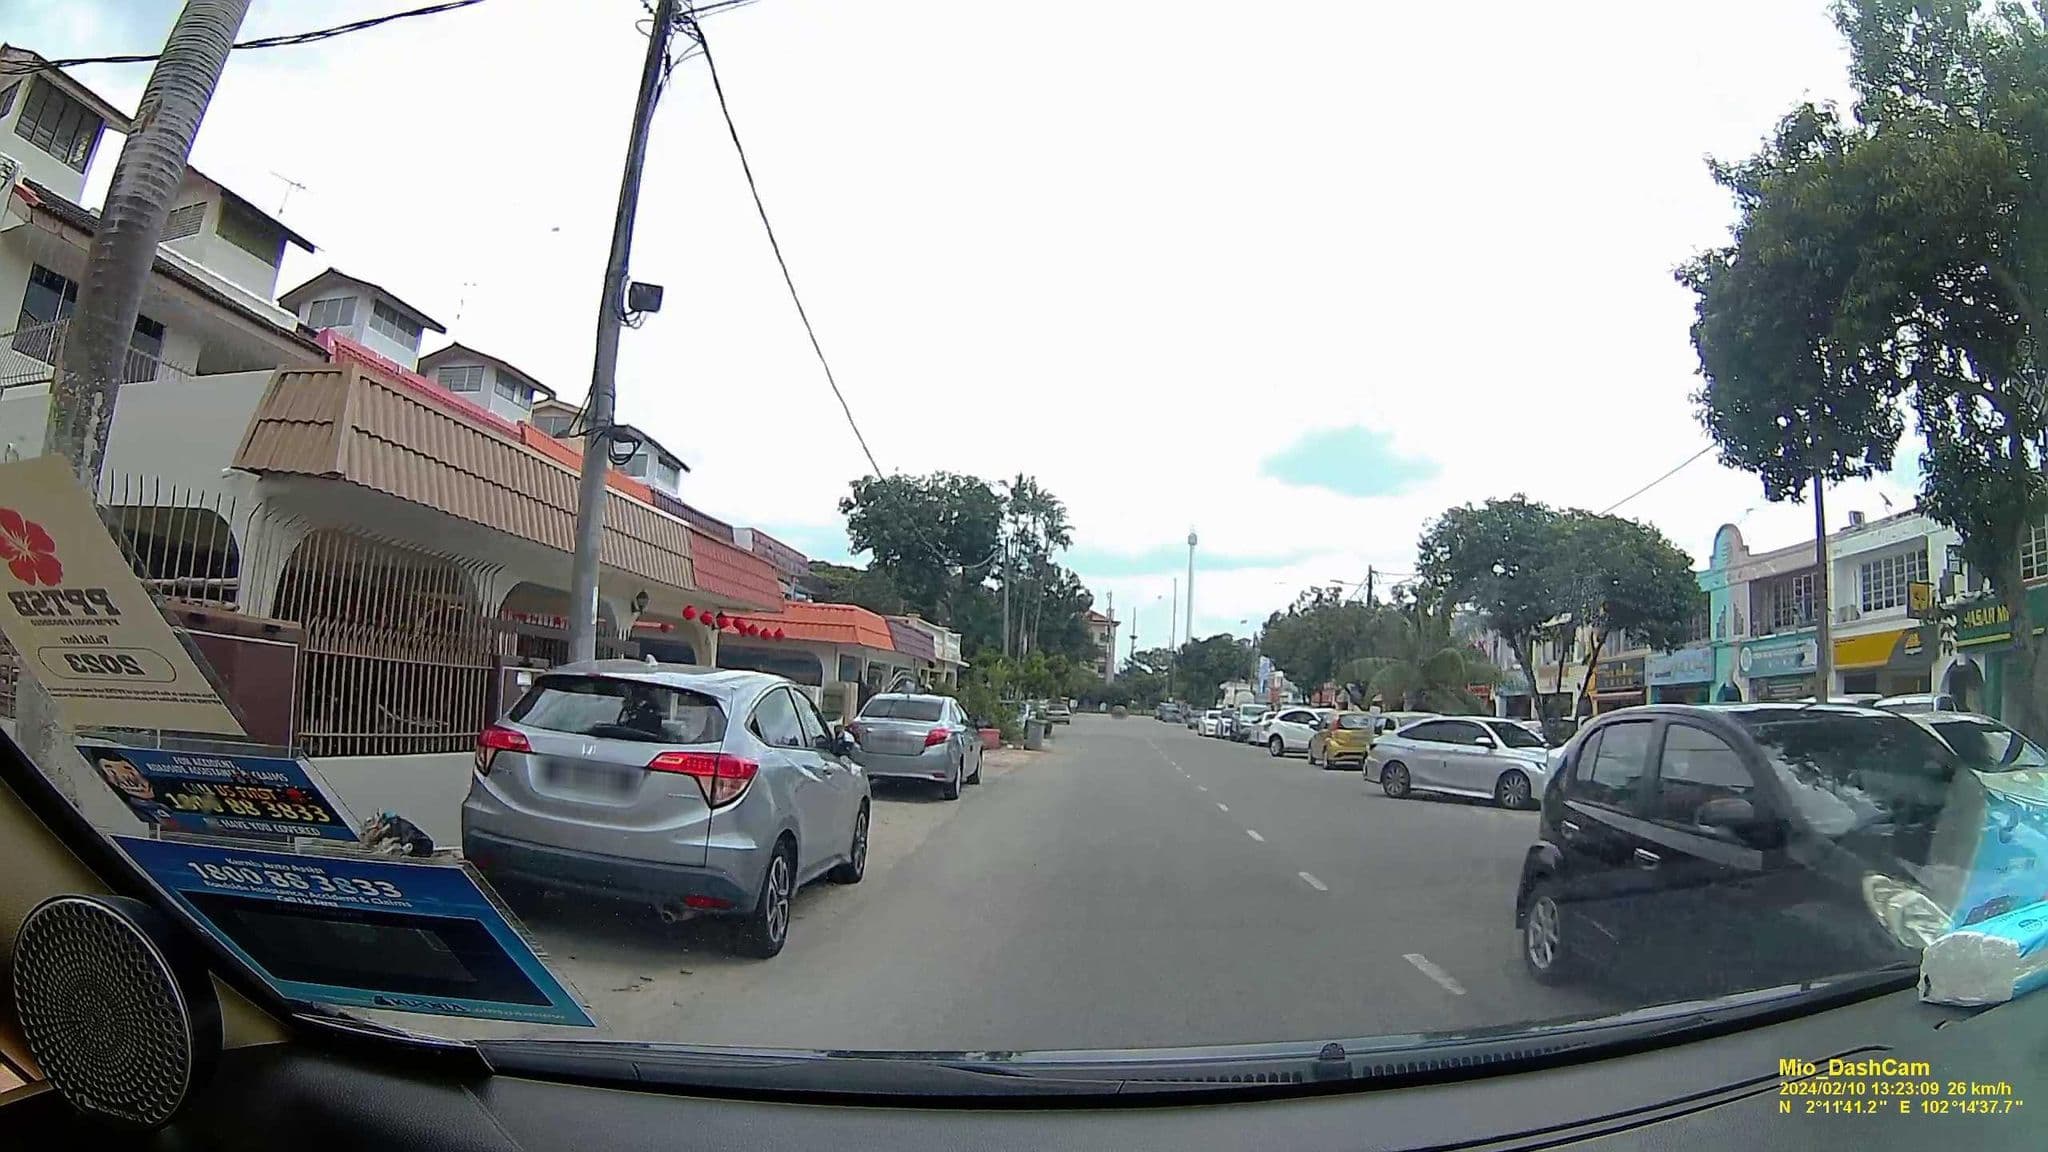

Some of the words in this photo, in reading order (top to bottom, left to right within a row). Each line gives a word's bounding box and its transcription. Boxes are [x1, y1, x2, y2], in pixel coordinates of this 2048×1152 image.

[1964, 607, 1995, 629] ASAR
[252, 771, 289, 783] CLAIMS
[214, 785, 236, 798] US
[234, 786, 278, 800] FIRST
[224, 798, 261, 816] 88
[261, 801, 331, 823] 3833
[249, 821, 274, 833] YOU
[275, 823, 321, 837] COVERED
[261, 862, 292, 872] Auto
[187, 861, 264, 886] 1800
[264, 869, 310, 891] 88
[310, 874, 403, 898] 3833
